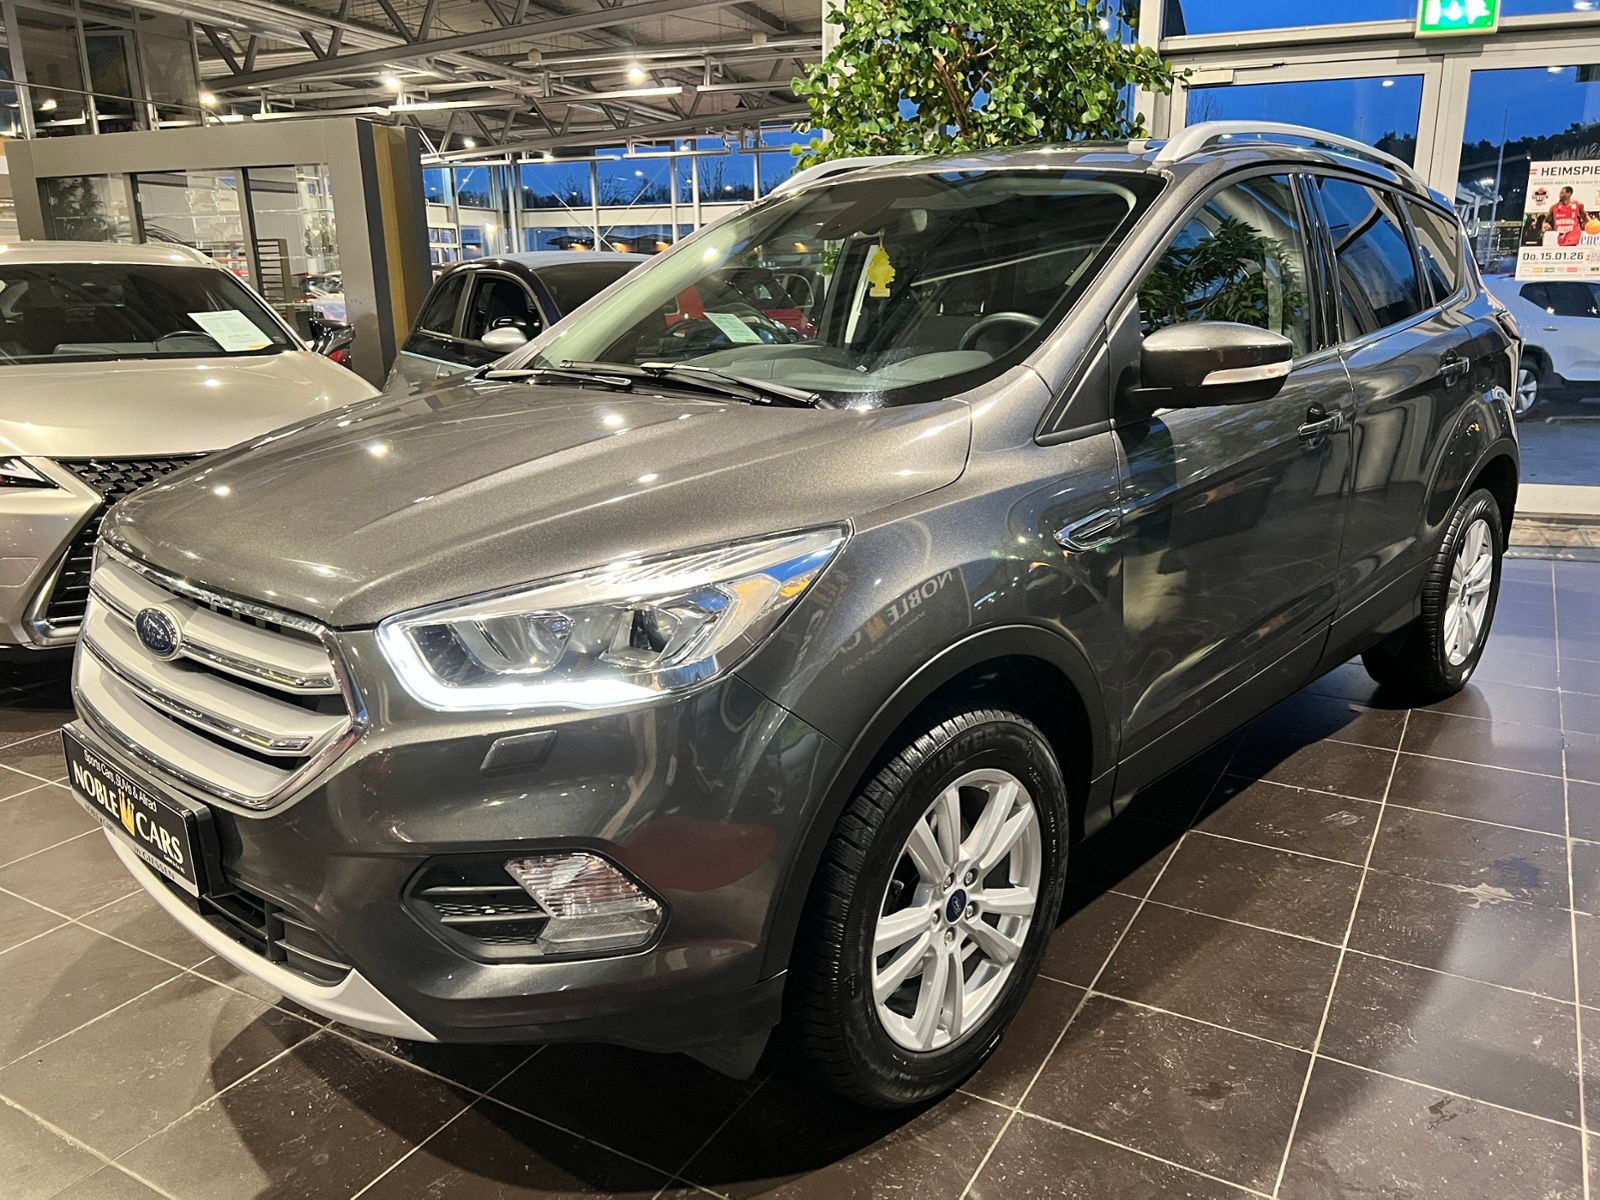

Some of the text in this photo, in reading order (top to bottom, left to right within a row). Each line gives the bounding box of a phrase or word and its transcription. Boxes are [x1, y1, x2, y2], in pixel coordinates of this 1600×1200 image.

[84, 750, 101, 771] Sports
[73, 760, 120, 819] NOBLE
[135, 811, 184, 865] CARS
